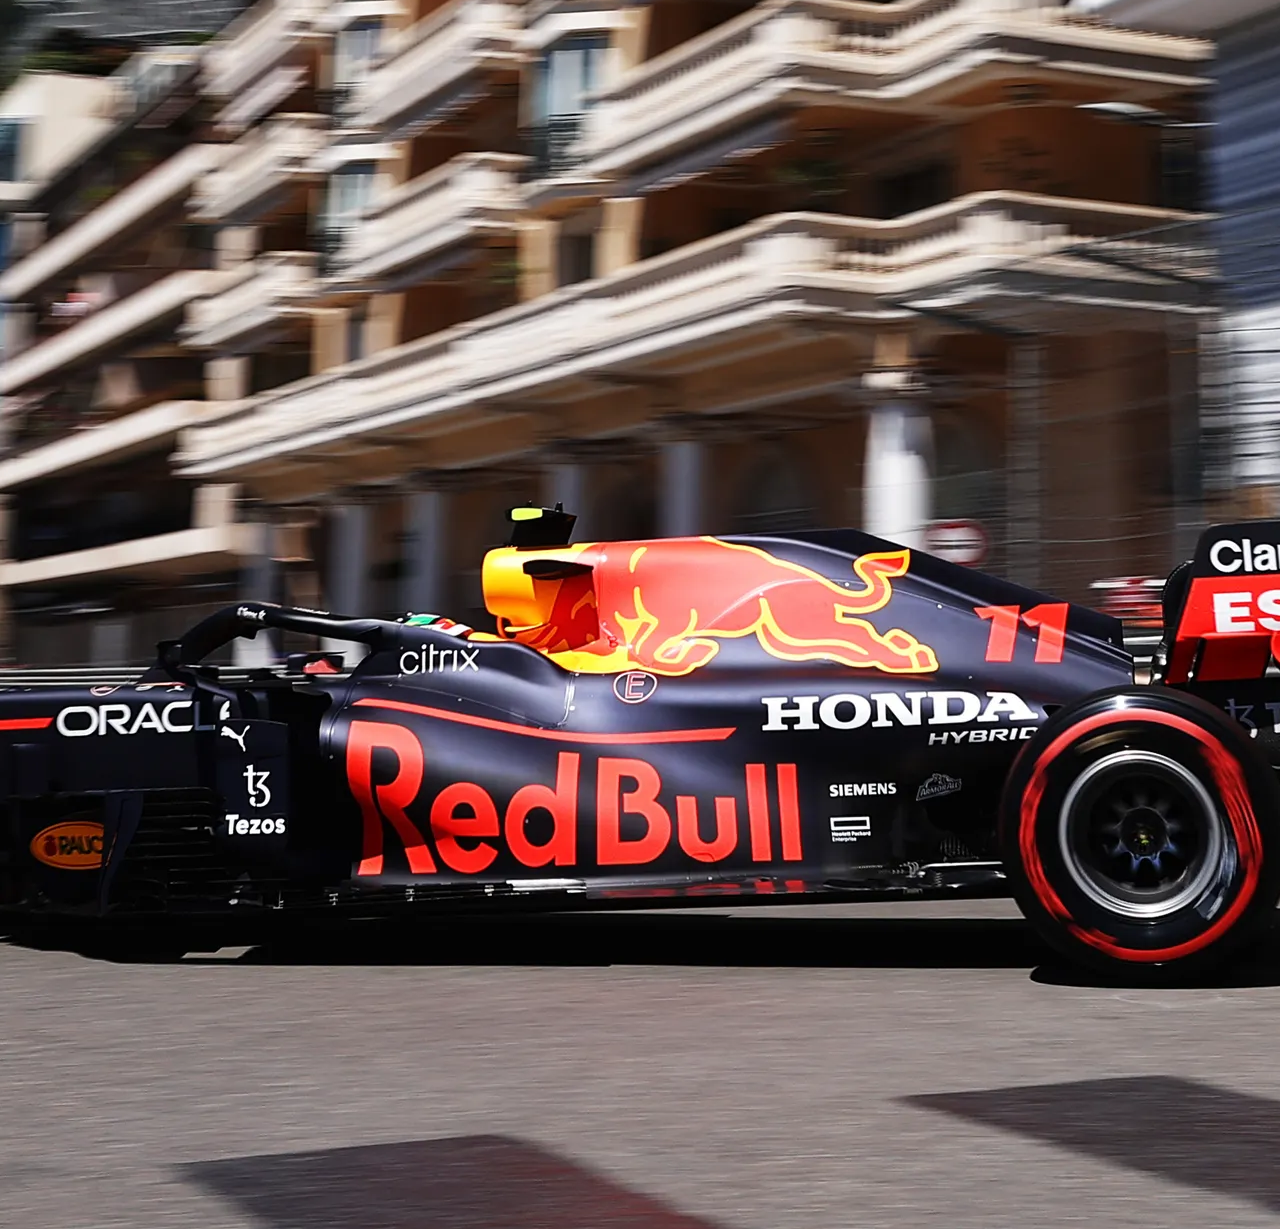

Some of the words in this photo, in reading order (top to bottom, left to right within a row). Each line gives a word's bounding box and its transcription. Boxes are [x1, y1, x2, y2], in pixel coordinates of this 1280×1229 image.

[973, 602, 1069, 663] 11
[399, 643, 480, 675] citrix
[56, 700, 216, 737] ORACL
[761, 691, 1039, 732] HONDA
[346, 721, 580, 875] Red
[596, 757, 803, 865] Bull
[829, 782, 897, 798] SIEMENS
[225, 814, 286, 835] Tezos
[59, 835, 104, 856] RAUC
